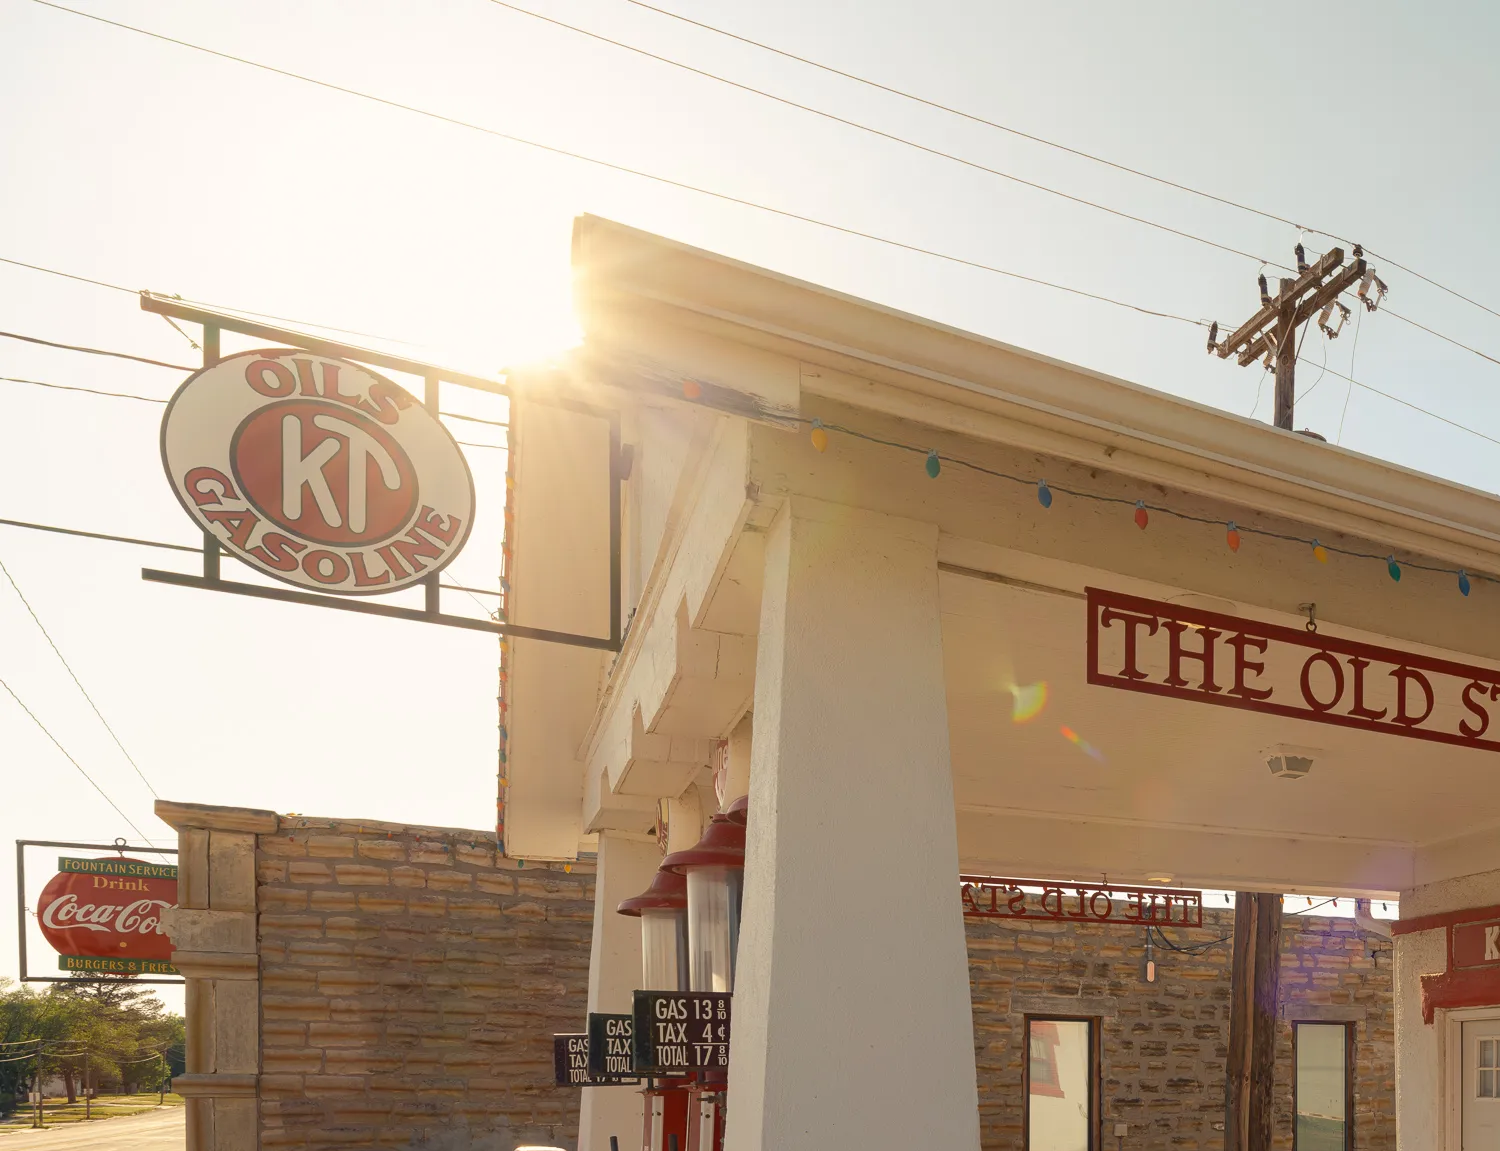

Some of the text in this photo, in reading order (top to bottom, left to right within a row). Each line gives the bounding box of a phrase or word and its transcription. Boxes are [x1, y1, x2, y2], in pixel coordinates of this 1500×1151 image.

[245, 358, 412, 425] OILS
[281, 414, 400, 534] KT
[184, 467, 461, 587] GASOLINE
[1101, 606, 1273, 700] THE
[1300, 651, 1434, 726] OLD
[64, 859, 177, 877] FOUNTAIN SERVICE
[93, 876, 150, 892] Drink
[43, 893, 179, 935] Coca-Co
[67, 957, 176, 973] BURGERS & FRIES
[655, 999, 688, 1020] GAS
[694, 999, 713, 1020] 13
[606, 1020, 632, 1036] GAS
[656, 1023, 688, 1043] TAX
[702, 1023, 713, 1043] 4
[606, 1038, 632, 1055] TAX
[656, 1045, 689, 1066] TOTAL
[694, 1045, 713, 1066] 17
[605, 1056, 632, 1073] TOTAL
